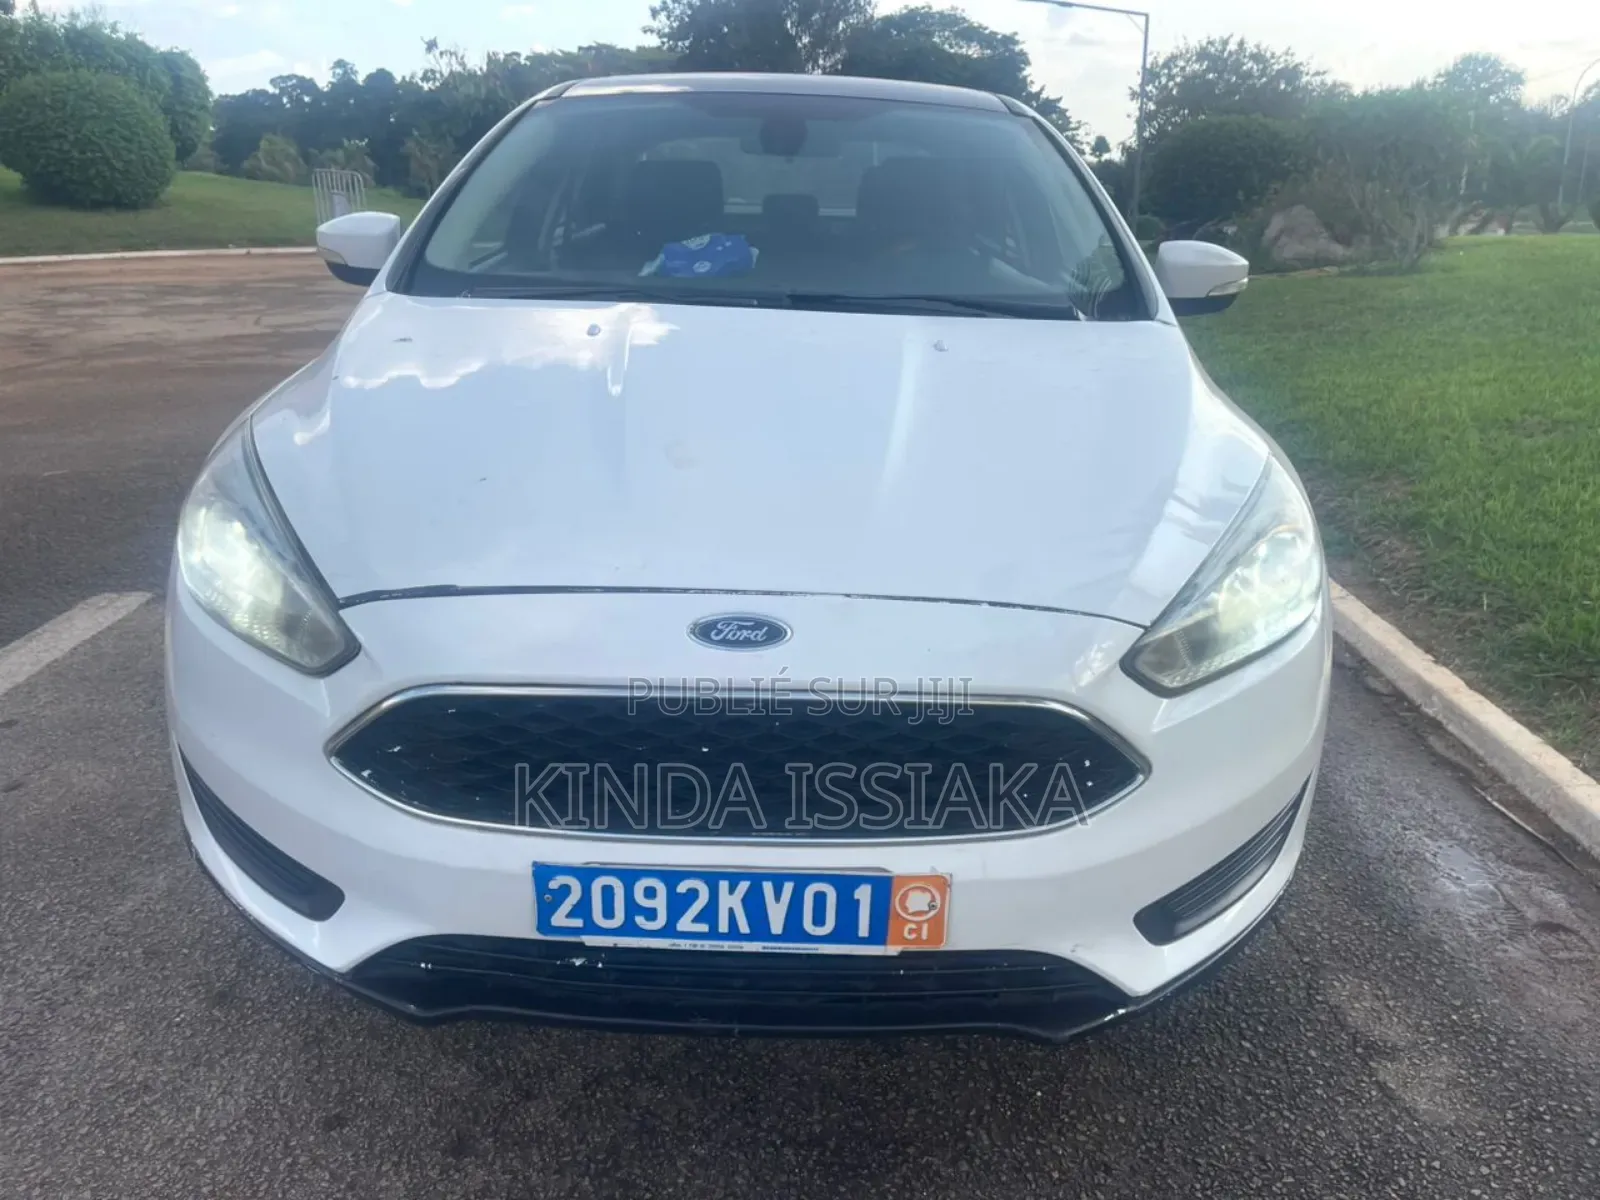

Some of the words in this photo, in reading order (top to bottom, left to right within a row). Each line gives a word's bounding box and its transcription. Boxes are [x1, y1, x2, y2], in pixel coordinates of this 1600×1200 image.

[710, 620, 769, 644] Ford
[548, 875, 872, 938] 2092KV01
[903, 922, 929, 941] CI
